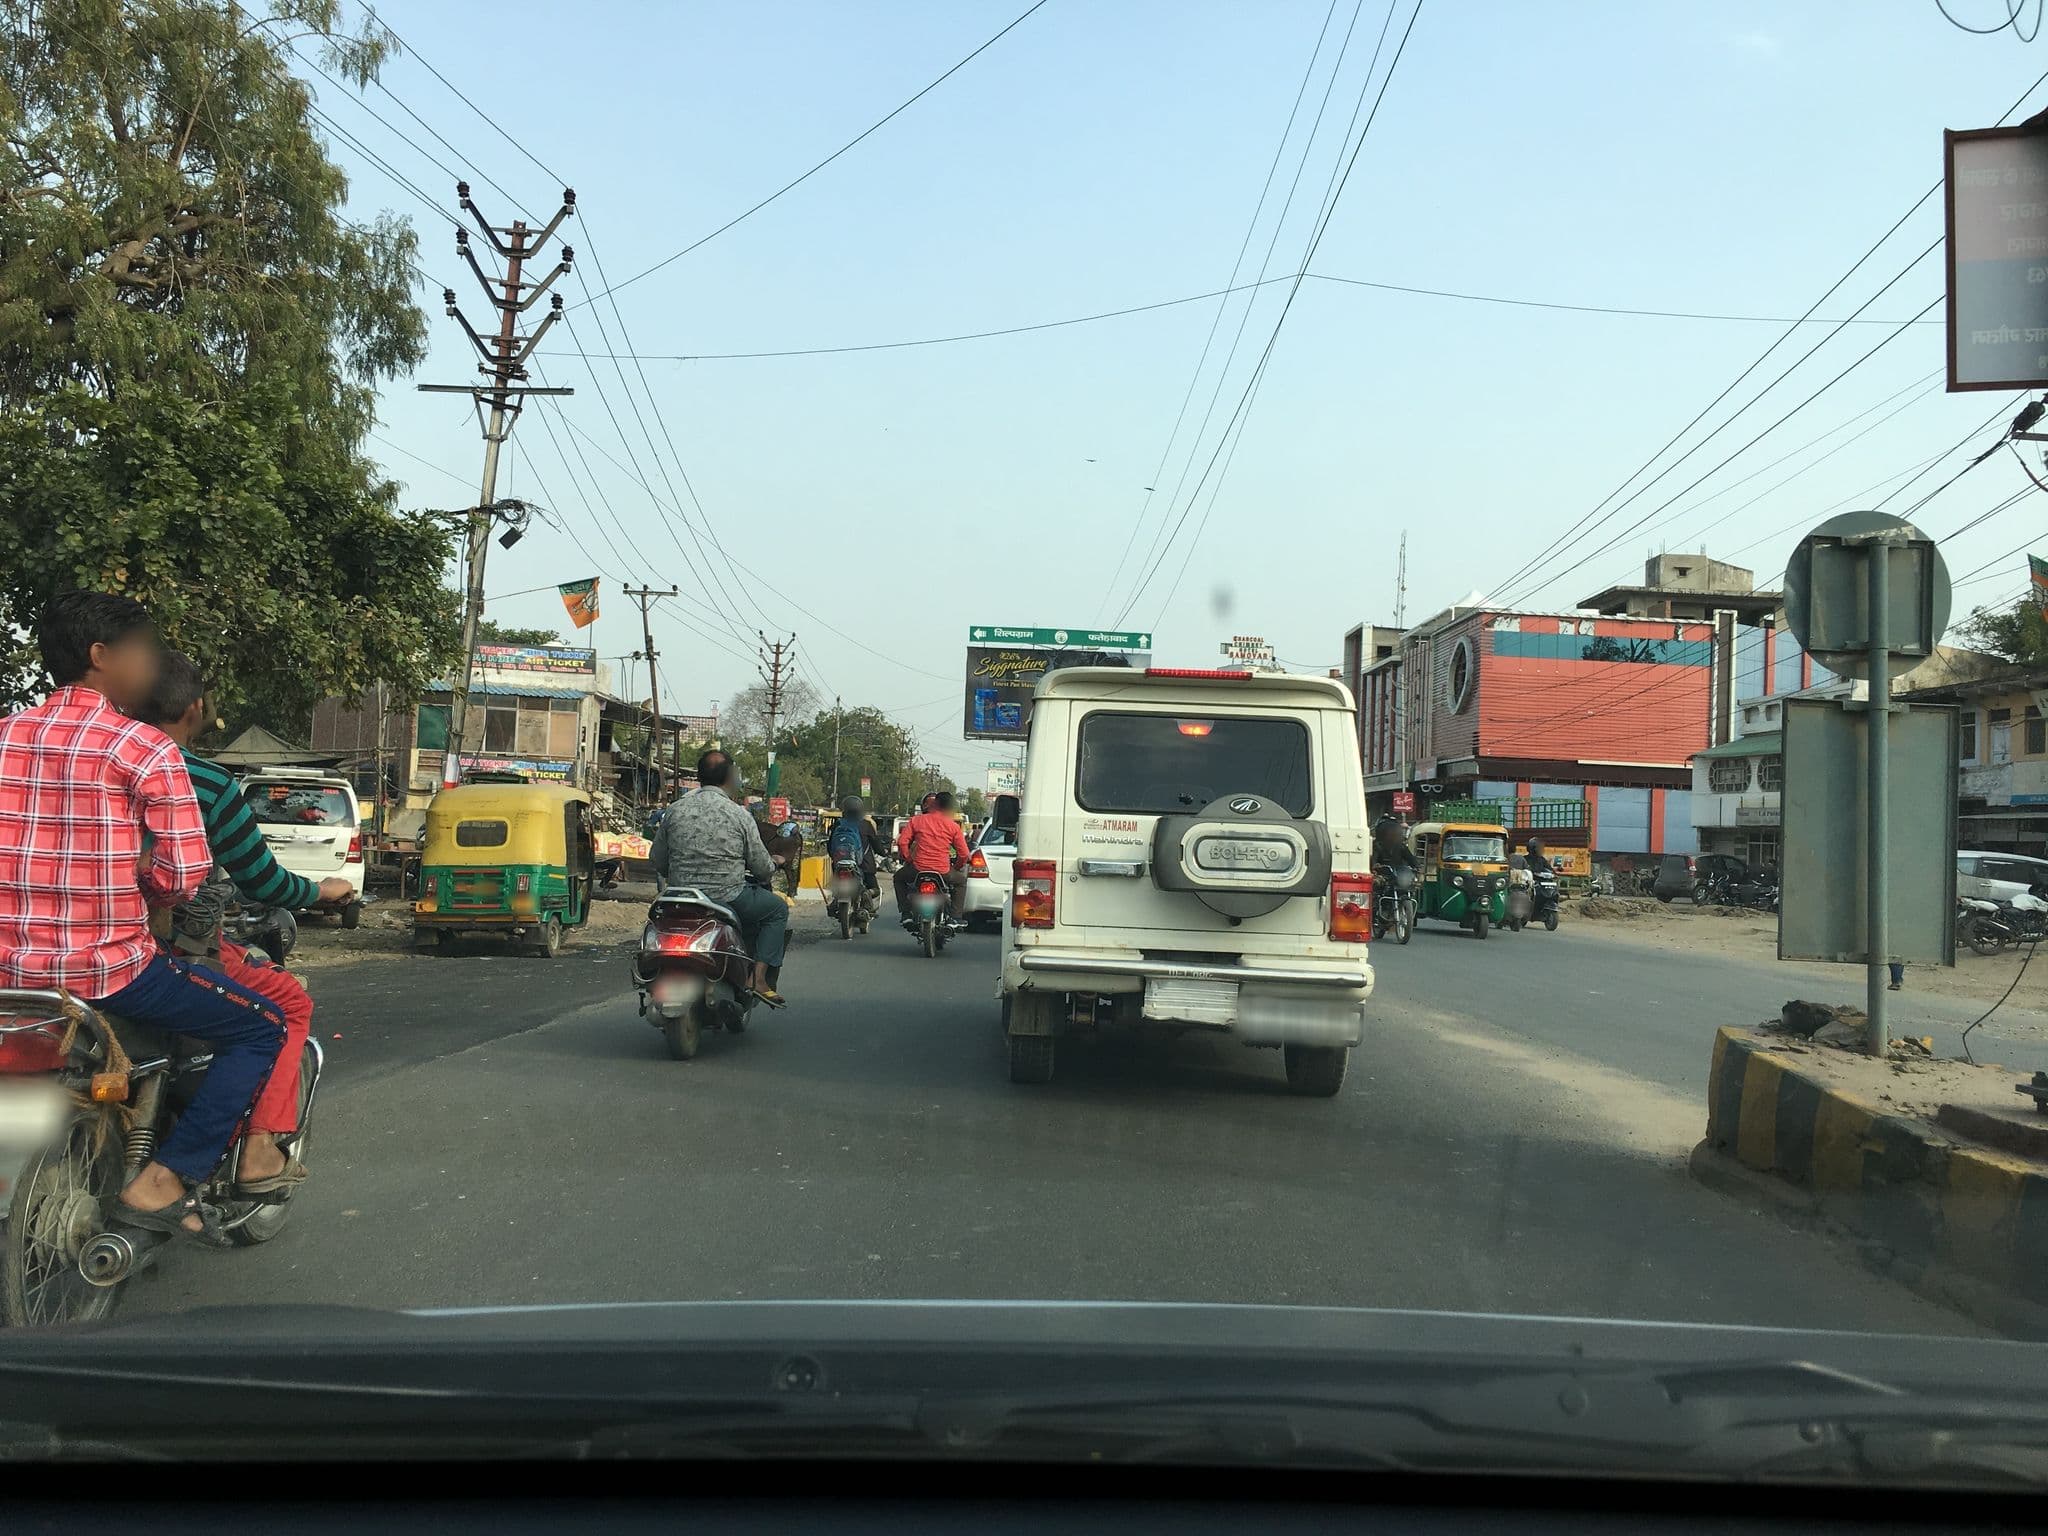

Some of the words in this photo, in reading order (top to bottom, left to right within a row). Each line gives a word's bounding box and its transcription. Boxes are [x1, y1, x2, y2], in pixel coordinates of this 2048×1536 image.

[994, 628, 1034, 639] शिल्पग्राम
[1088, 632, 1129, 643] फतेहाबाद
[527, 657, 544, 665] AIR
[548, 659, 586, 667] TICKET
[536, 771, 566, 779] TICKET
[1103, 819, 1138, 832] ATMARAM
[1082, 834, 1144, 846] Mahindra
[1209, 846, 1281, 869] BOLERO
